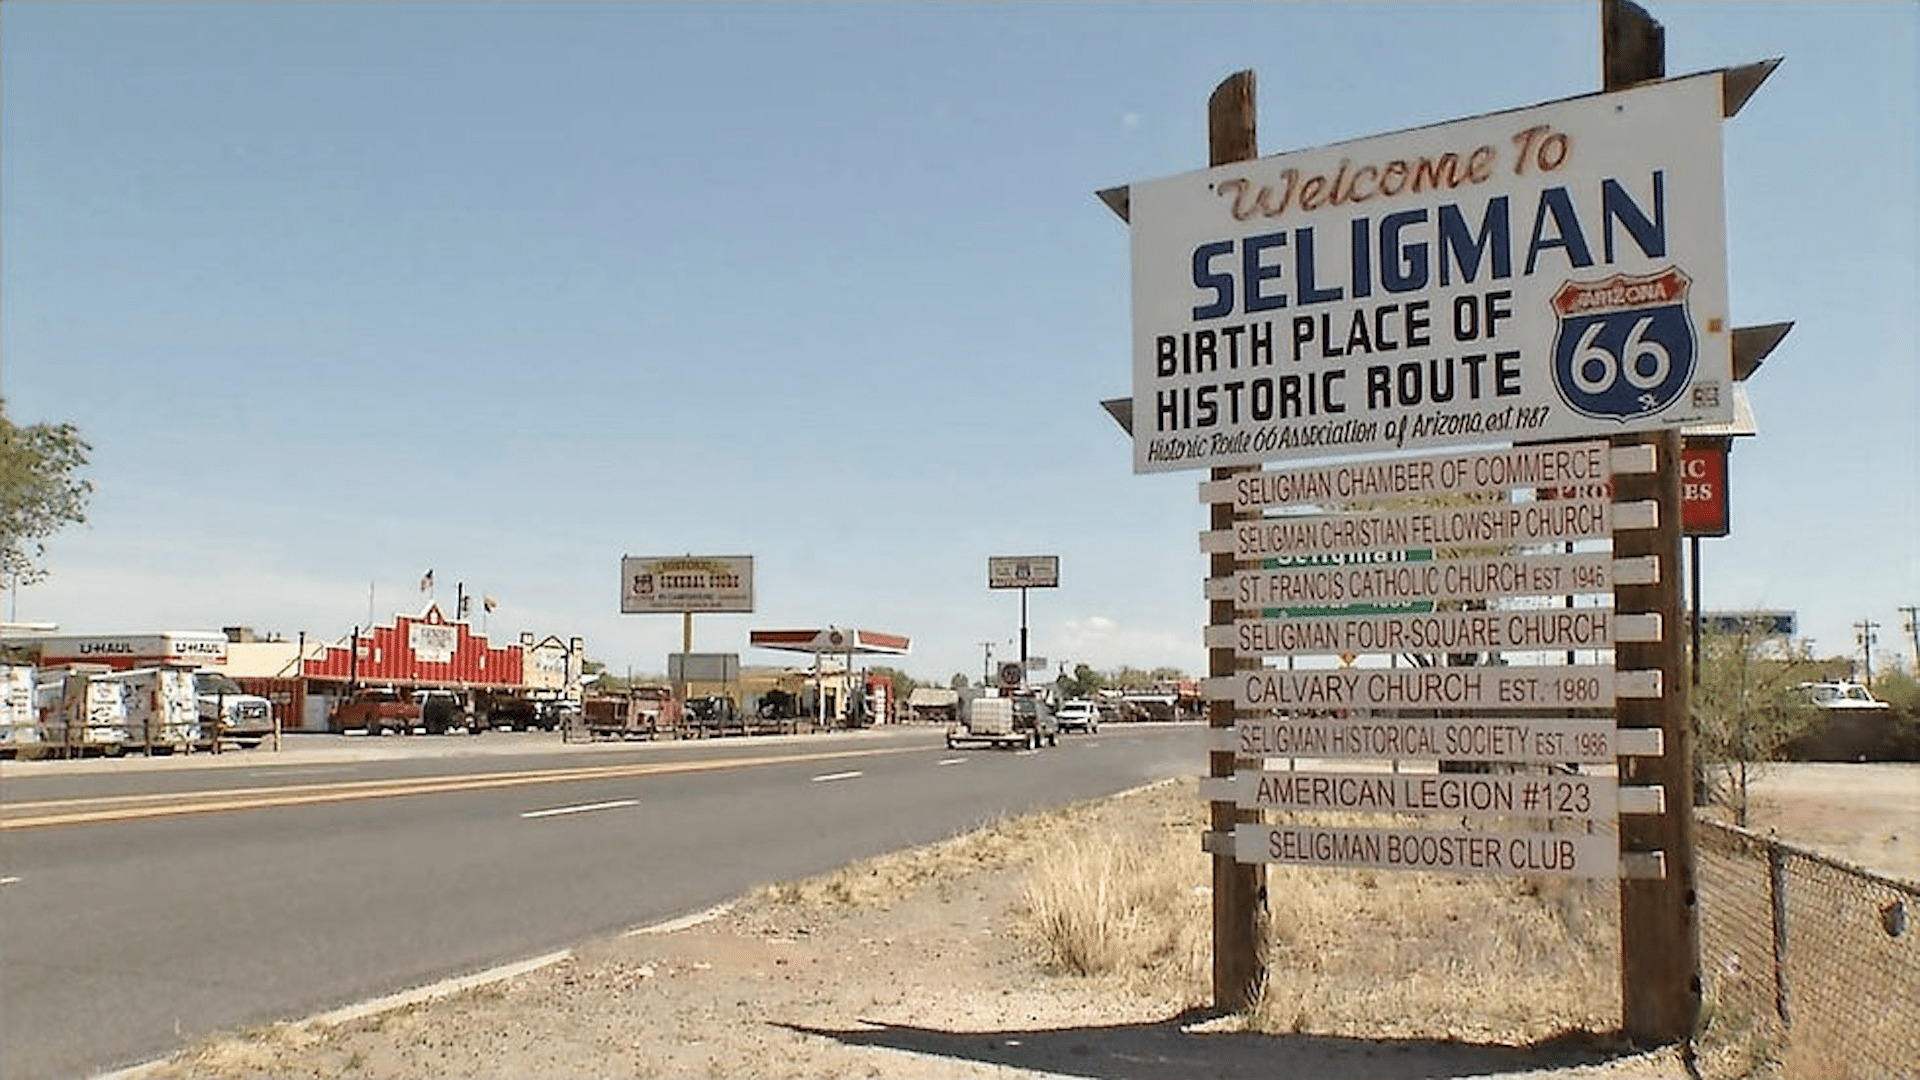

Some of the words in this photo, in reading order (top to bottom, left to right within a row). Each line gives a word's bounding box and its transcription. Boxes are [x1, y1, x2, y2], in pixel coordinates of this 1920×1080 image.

[1217, 145, 1495, 220] Welcome
[1512, 124, 1568, 175] To
[1193, 170, 1666, 321] SELIGMAN
[1157, 325, 1272, 377] BIRTH
[1293, 301, 1430, 361] PLACE
[1454, 290, 1512, 341] OF
[1571, 316, 1671, 394] 66
[1157, 369, 1345, 431] HISTORIC
[1367, 351, 1521, 409] ROUTE
[1148, 436, 1208, 461] Historic
[1210, 429, 1252, 455] Route
[1253, 426, 1278, 452] 66
[1278, 419, 1378, 449] Association
[1384, 415, 1407, 448] of
[1237, 471, 1332, 505] SELIGMAN
[1337, 462, 1435, 498] CHAMBER
[1441, 459, 1468, 489] OF
[1475, 449, 1601, 486] COMMERCE
[1239, 523, 1317, 554] SELIGMAN
[1321, 518, 1408, 549] CHRISTIAN
[1412, 509, 1521, 544] FELLOWSHIP
[1526, 504, 1604, 537] CHURCH
[1239, 576, 1266, 603] ST.
[1270, 571, 1345, 601] FRANCIS
[1349, 566, 1439, 599] CATHOLIC
[1445, 562, 1528, 594] CHURCH
[1239, 623, 1339, 651] SELIGMAN
[1346, 617, 1501, 649] FOUR-SQUARE
[1508, 613, 1608, 646] CHURCH
[1247, 674, 1359, 703] CALVARY
[1368, 673, 1482, 702] CHURCH
[1555, 678, 1600, 701] 1980
[1241, 725, 1327, 754] SELIGMAN
[1333, 725, 1440, 755] HISTORICAL
[1445, 725, 1530, 755] SOCIETY
[1257, 777, 1396, 807] AMERICAN
[1405, 780, 1514, 811] LEGION
[1521, 782, 1592, 813] #123
[1269, 830, 1381, 862] SELIGMAN
[1387, 835, 1502, 868] BOOSTER
[1509, 838, 1577, 871] CLUB
